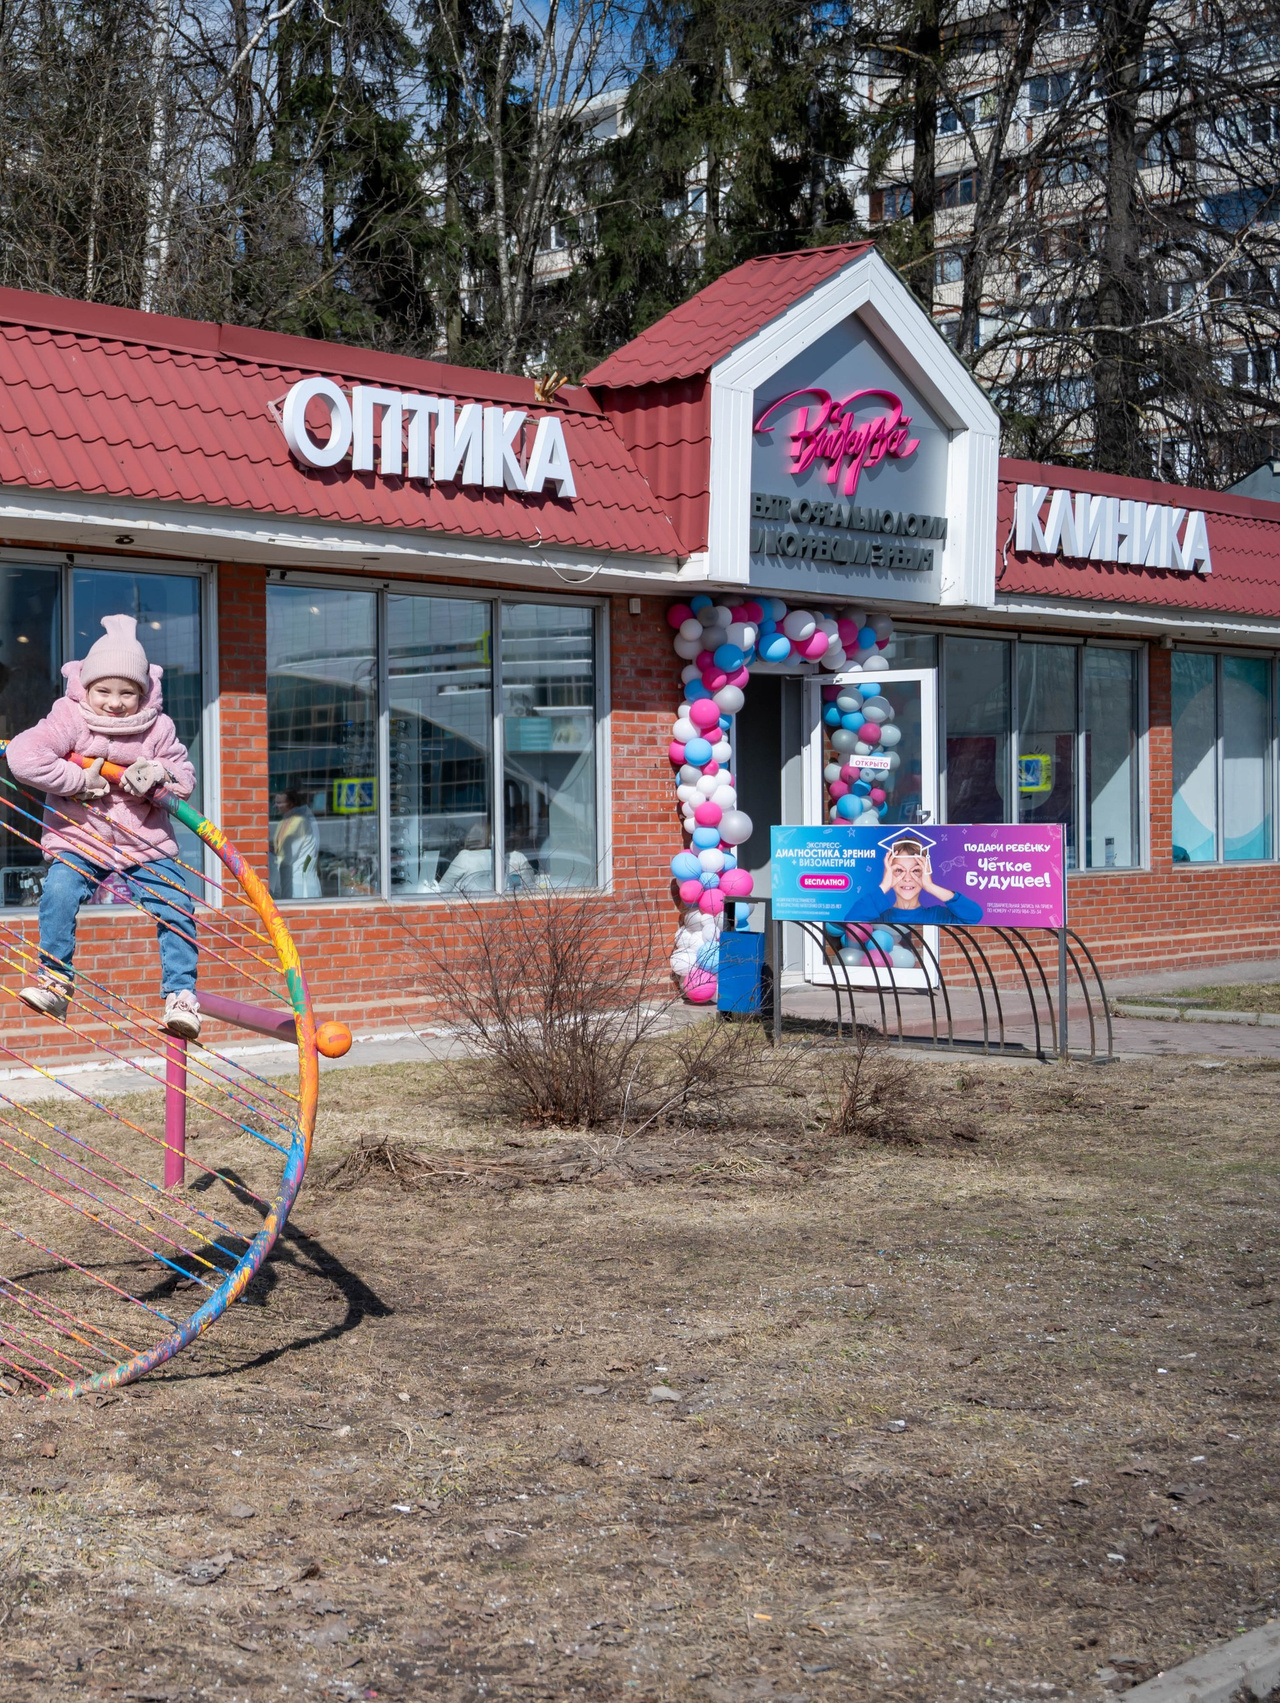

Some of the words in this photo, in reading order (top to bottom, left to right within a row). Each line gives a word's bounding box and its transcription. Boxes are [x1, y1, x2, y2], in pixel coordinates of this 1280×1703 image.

[283, 377, 577, 498] ОПТИКА
[751, 492, 791, 520] ЕНТР
[791, 498, 948, 540] ОФТАЛЬМОЛОГИИ
[1015, 484, 1212, 573] КЛИНИКА
[765, 529, 872, 565] КОРРЕКЦИИ
[871, 542, 933, 571] ЗРЕНИЯ
[855, 760, 889, 768] ОТКРЫТО
[775, 849, 840, 858] ДИАГНОСТИКА
[842, 849, 876, 858] ЗРЕНИЯ
[964, 843, 1003, 853] ПОДАРИ
[799, 859, 856, 867] ВИЗОМЕТРИЯ
[978, 857, 1032, 872] Чёткое
[965, 871, 1051, 890] Будущее!
